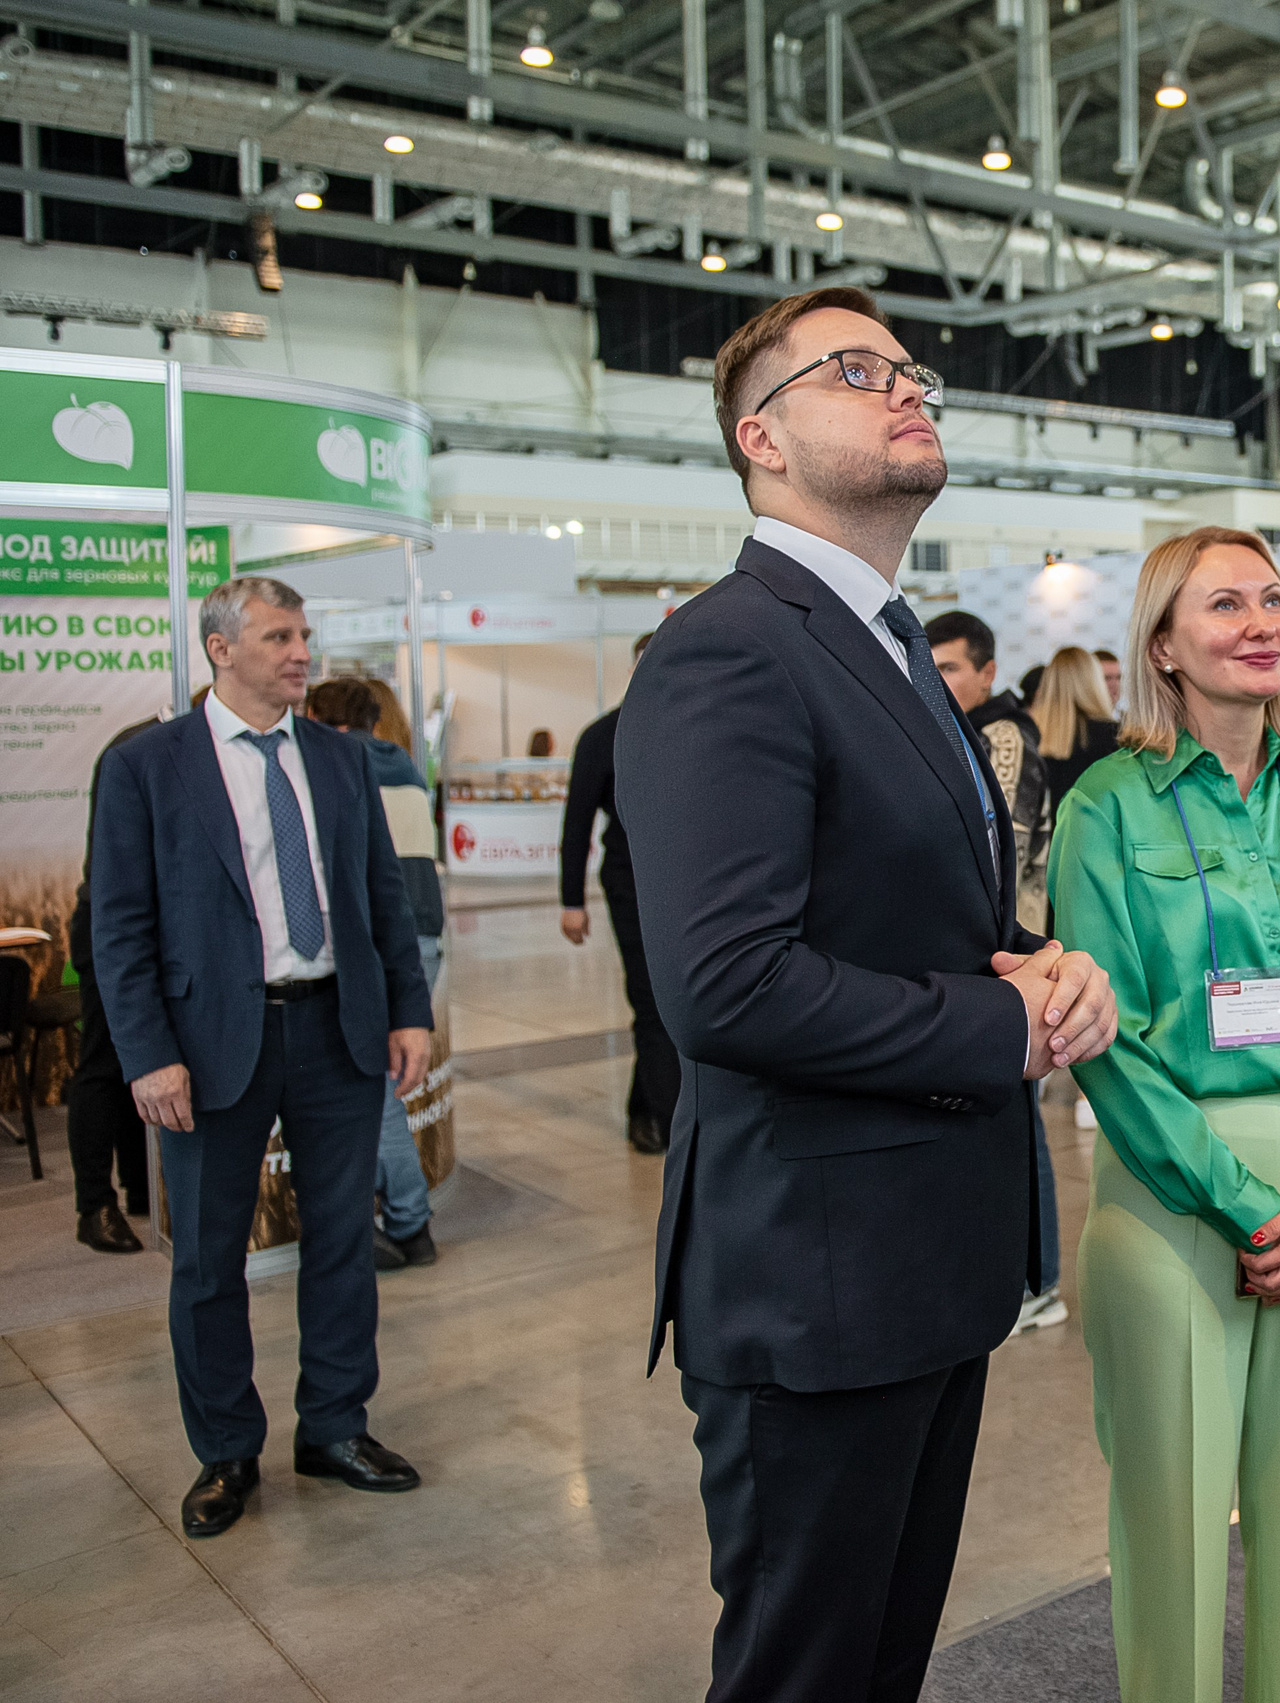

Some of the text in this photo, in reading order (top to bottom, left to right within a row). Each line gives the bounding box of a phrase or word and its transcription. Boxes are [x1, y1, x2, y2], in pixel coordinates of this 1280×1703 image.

[0, 534, 217, 566] ОД ЗАЩИТЙ!
[26, 567, 60, 585] для
[64, 568, 150, 586] зерновых
[66, 614, 85, 637] В
